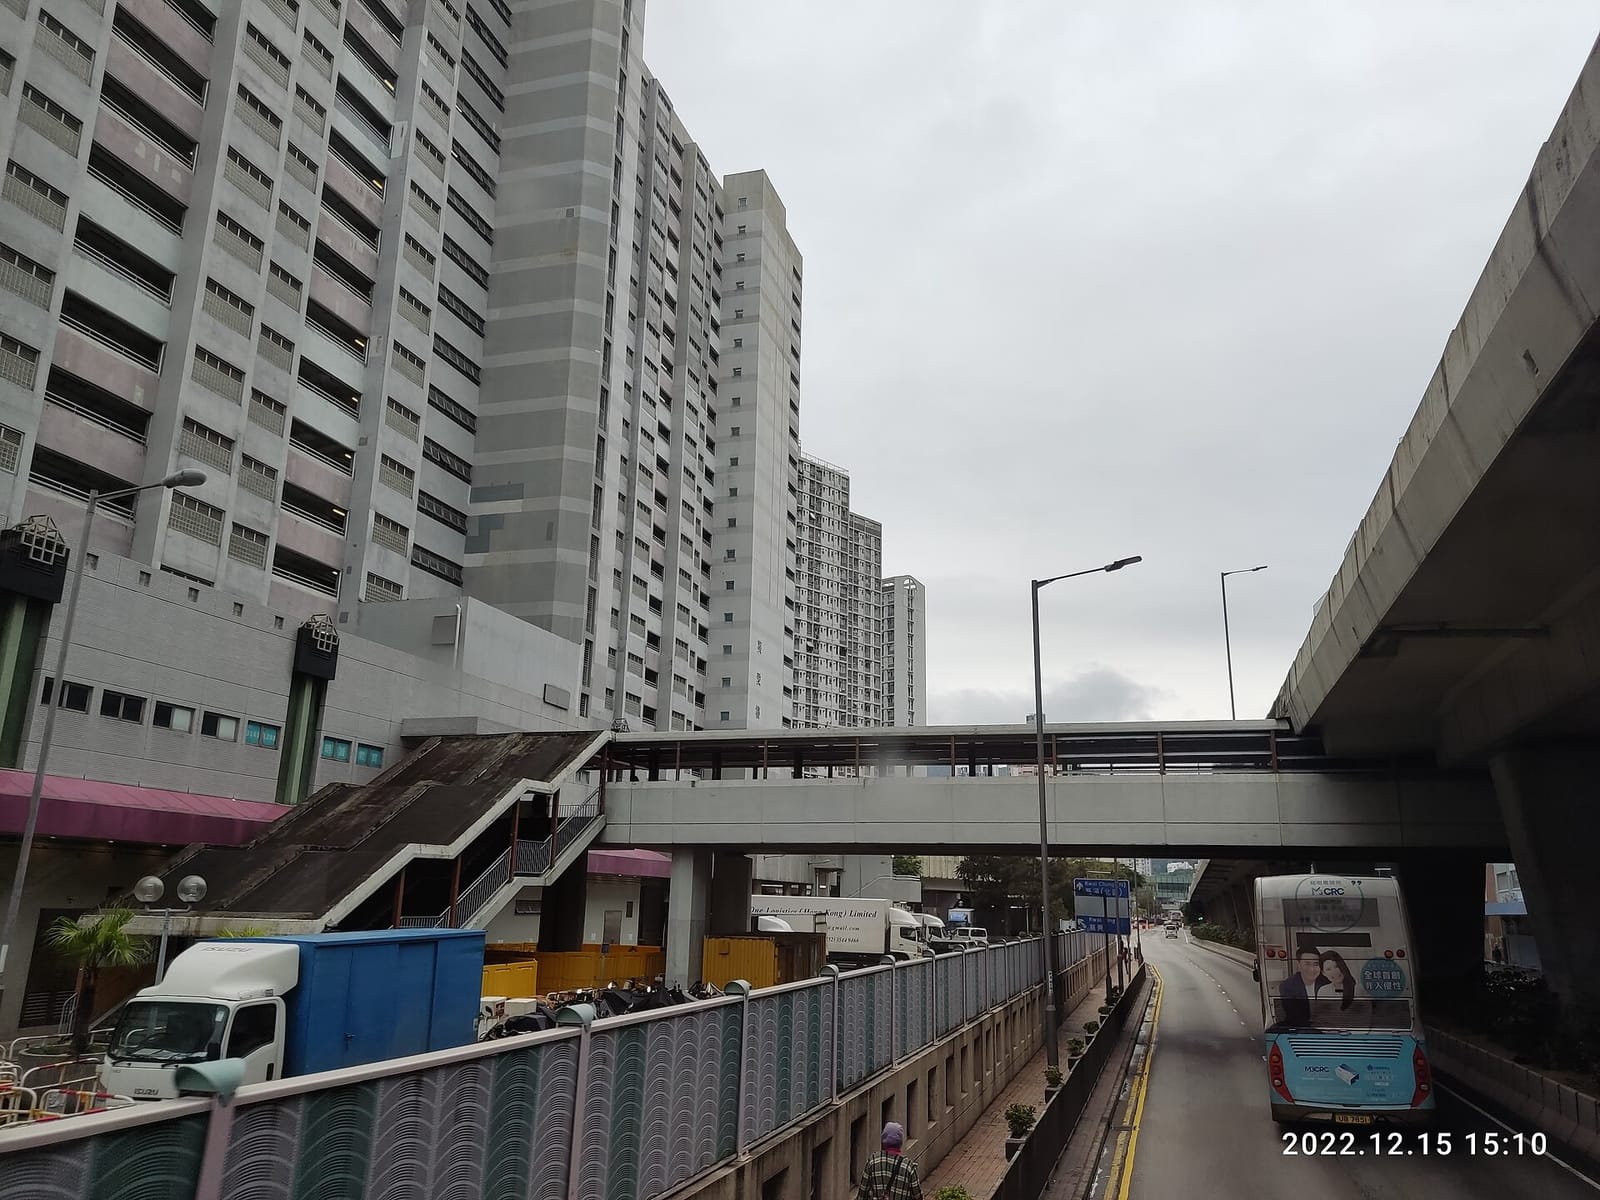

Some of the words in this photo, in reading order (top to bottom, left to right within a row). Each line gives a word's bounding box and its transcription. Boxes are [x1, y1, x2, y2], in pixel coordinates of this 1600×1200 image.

[850, 909, 878, 918] Limited
[202, 945, 255, 953] ISUZU
[134, 1088, 159, 1096] ISUZU
